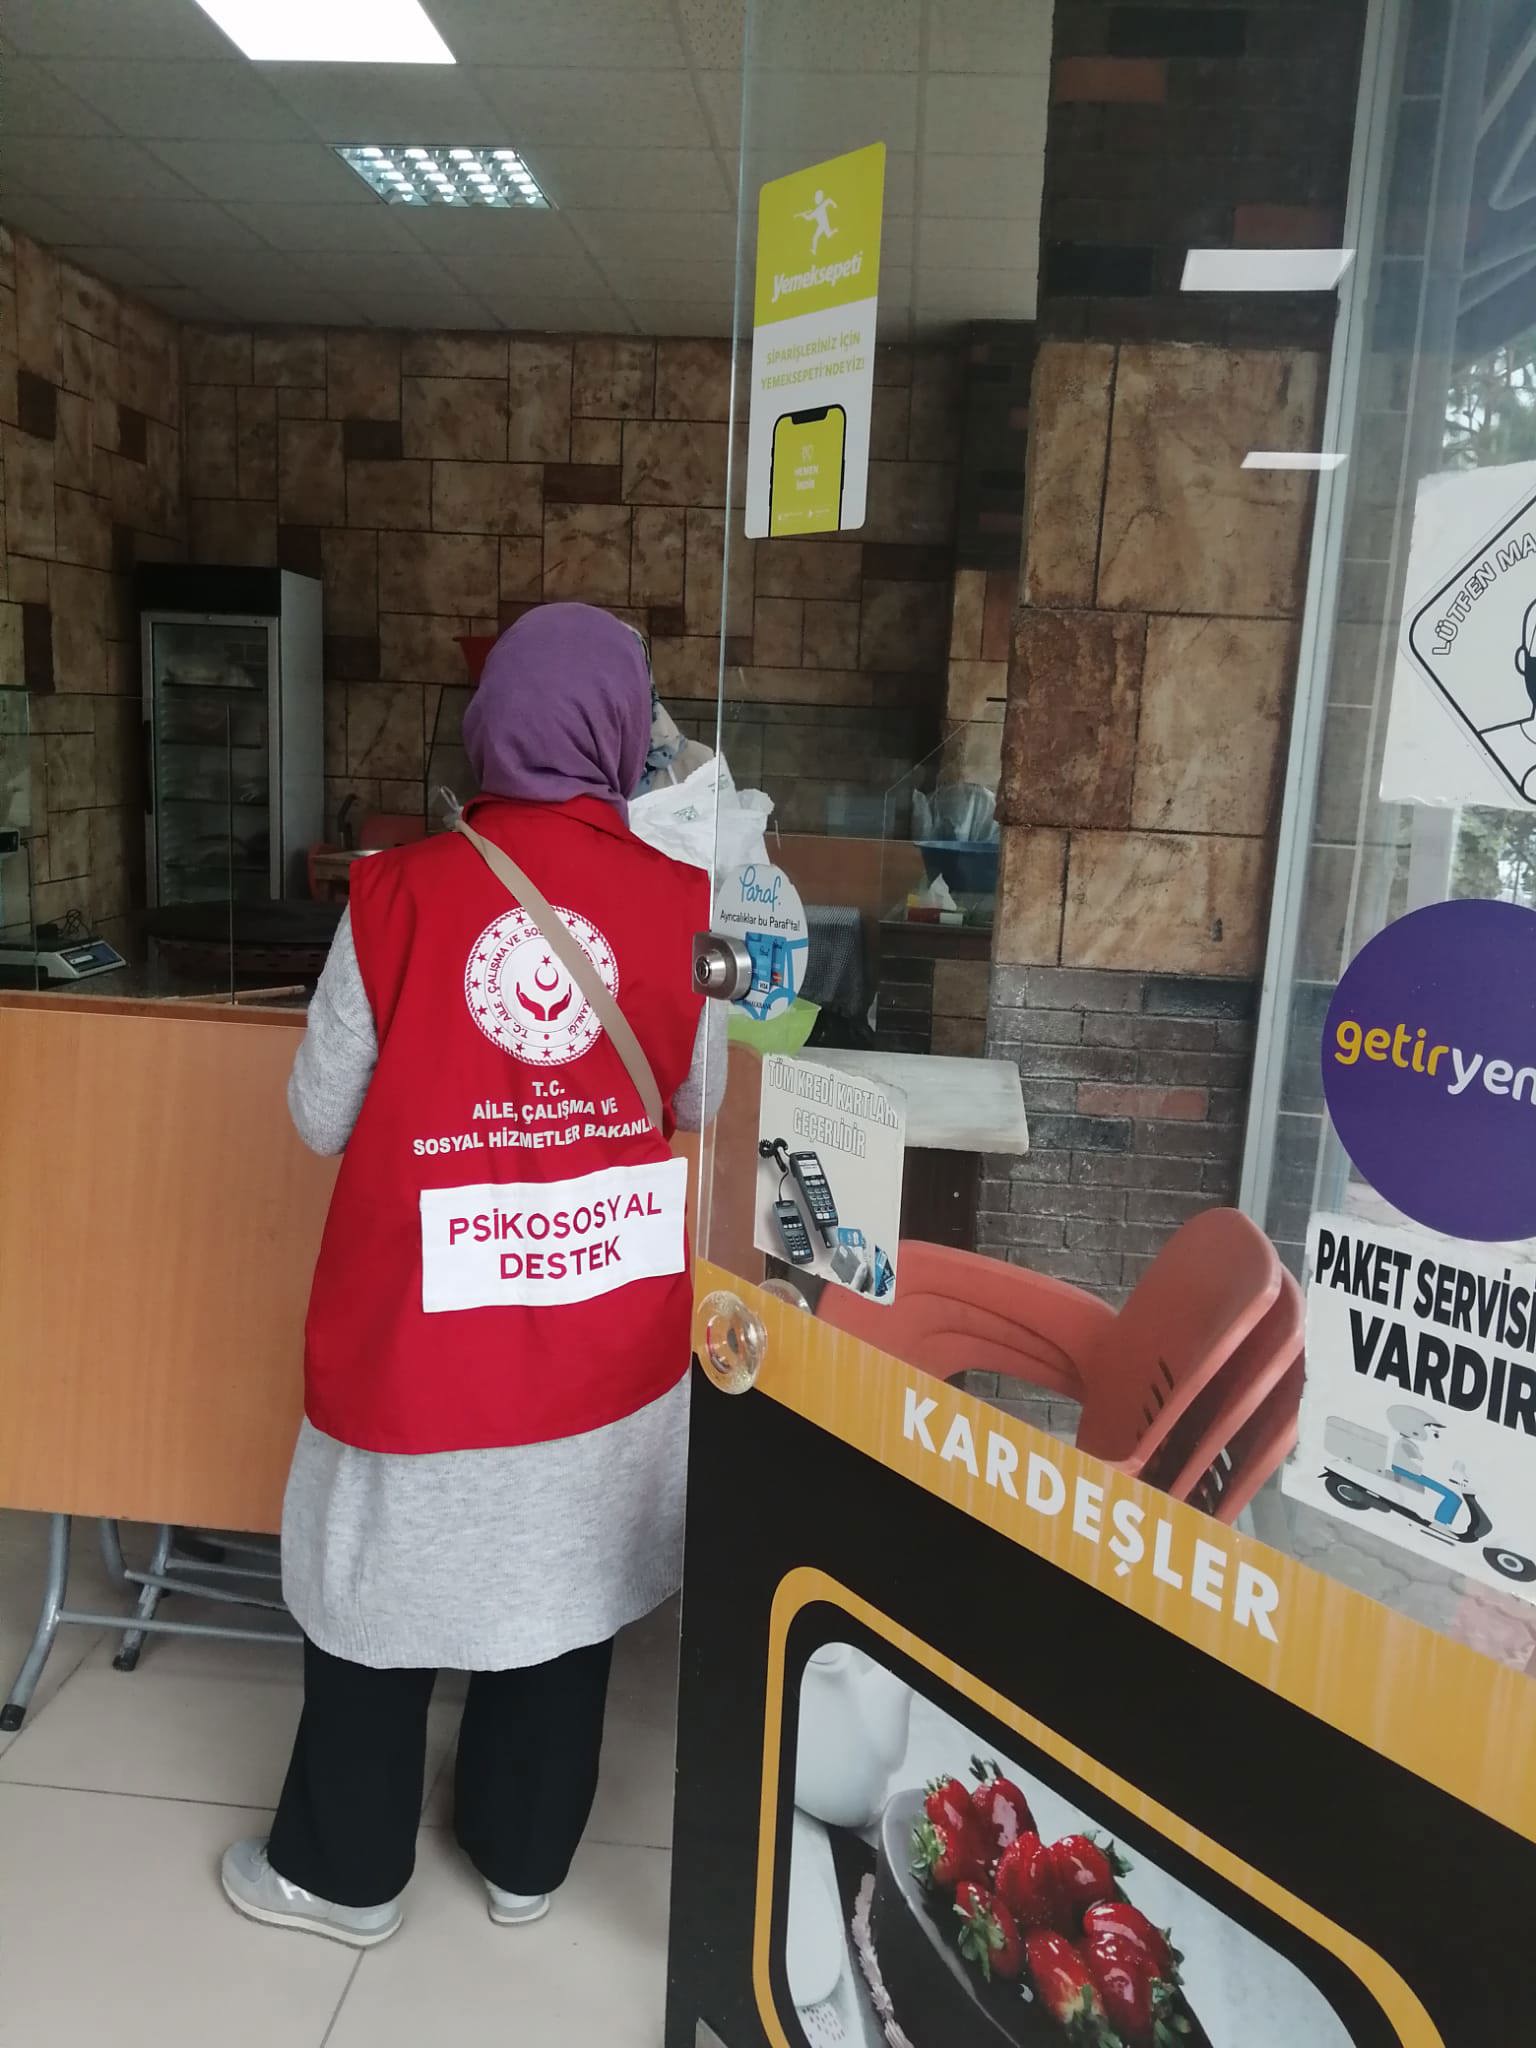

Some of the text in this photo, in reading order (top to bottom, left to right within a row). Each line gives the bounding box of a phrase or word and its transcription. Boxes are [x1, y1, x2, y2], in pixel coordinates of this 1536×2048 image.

[771, 250, 864, 304] Yemeksepeti
[1432, 561, 1497, 655] LÜTFEN
[505, 934, 521, 947] VE
[757, 914, 768, 927] bu
[531, 1079, 565, 1098] T.C.
[769, 1057, 795, 1093] TÜM
[797, 1068, 834, 1108] KREDİ
[472, 1096, 619, 1125] AİLE, ÇALIŞMA VE
[793, 1107, 867, 1159] GEÇERLİDİR
[413, 1133, 484, 1156] SOSYAL
[488, 1125, 581, 1149] HİZMETLER
[449, 1191, 662, 1246] PSİKOSOSYAL
[499, 1236, 622, 1280] DESTEK
[1315, 1228, 1413, 1311] PAKET
[1349, 1307, 1536, 1438] VARDIR
[903, 1387, 1279, 1643] KARDEŞLER
